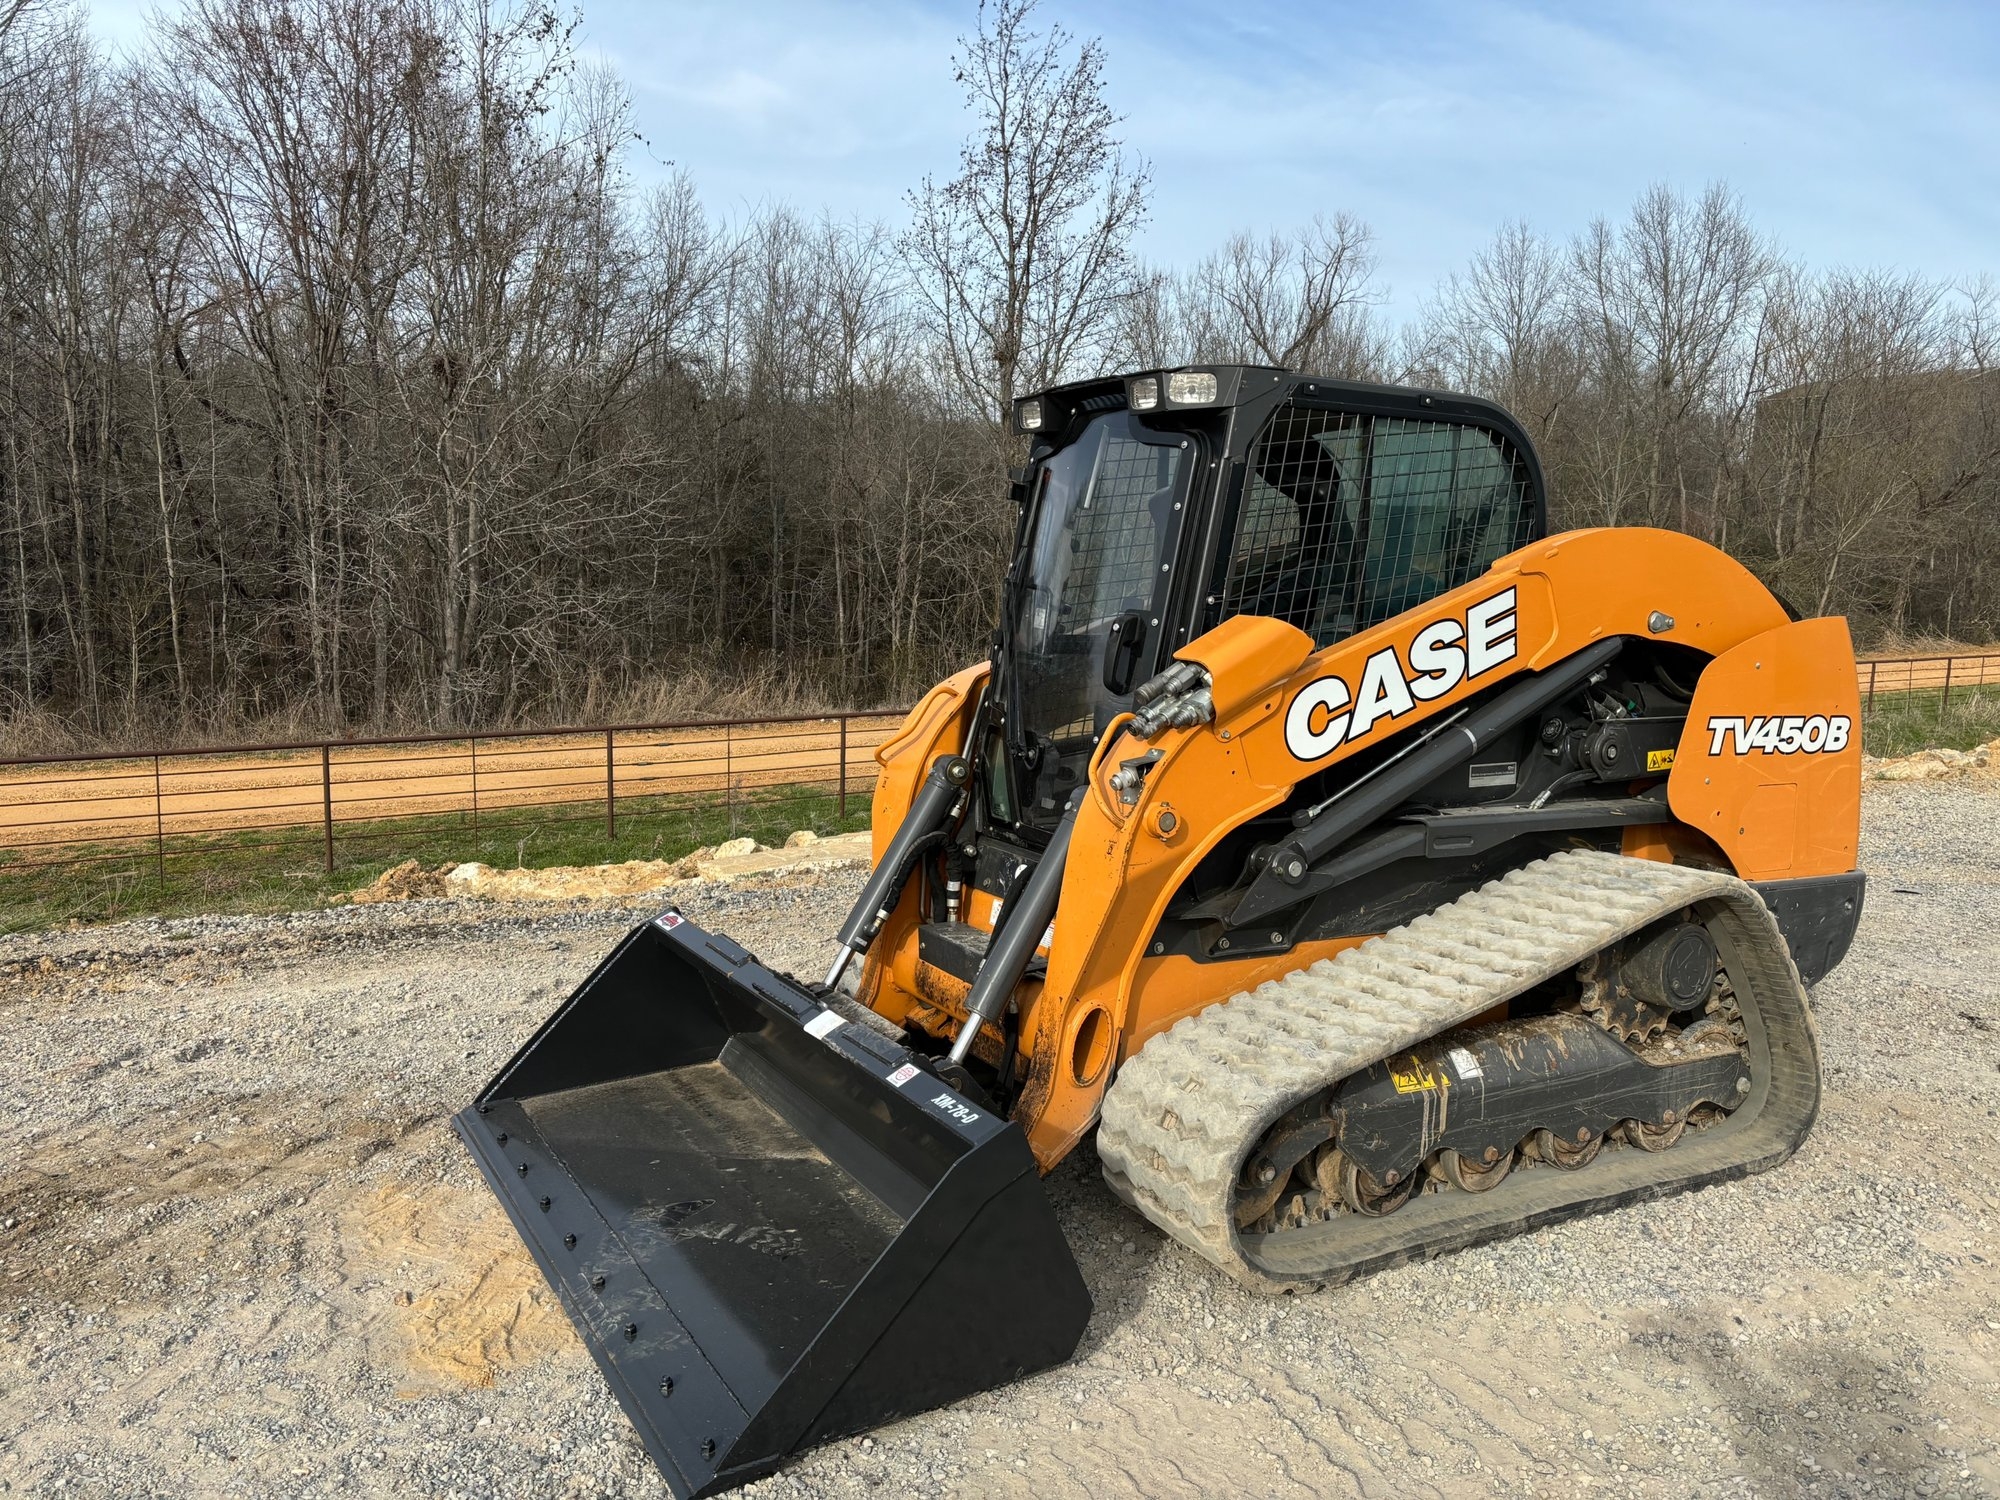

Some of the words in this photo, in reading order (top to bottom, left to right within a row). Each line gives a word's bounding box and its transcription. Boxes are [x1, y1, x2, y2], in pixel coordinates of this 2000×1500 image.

[1284, 584, 1517, 762] CASE
[1707, 714, 1851, 756] TV450B
[930, 1093, 979, 1124] XM-78-D
